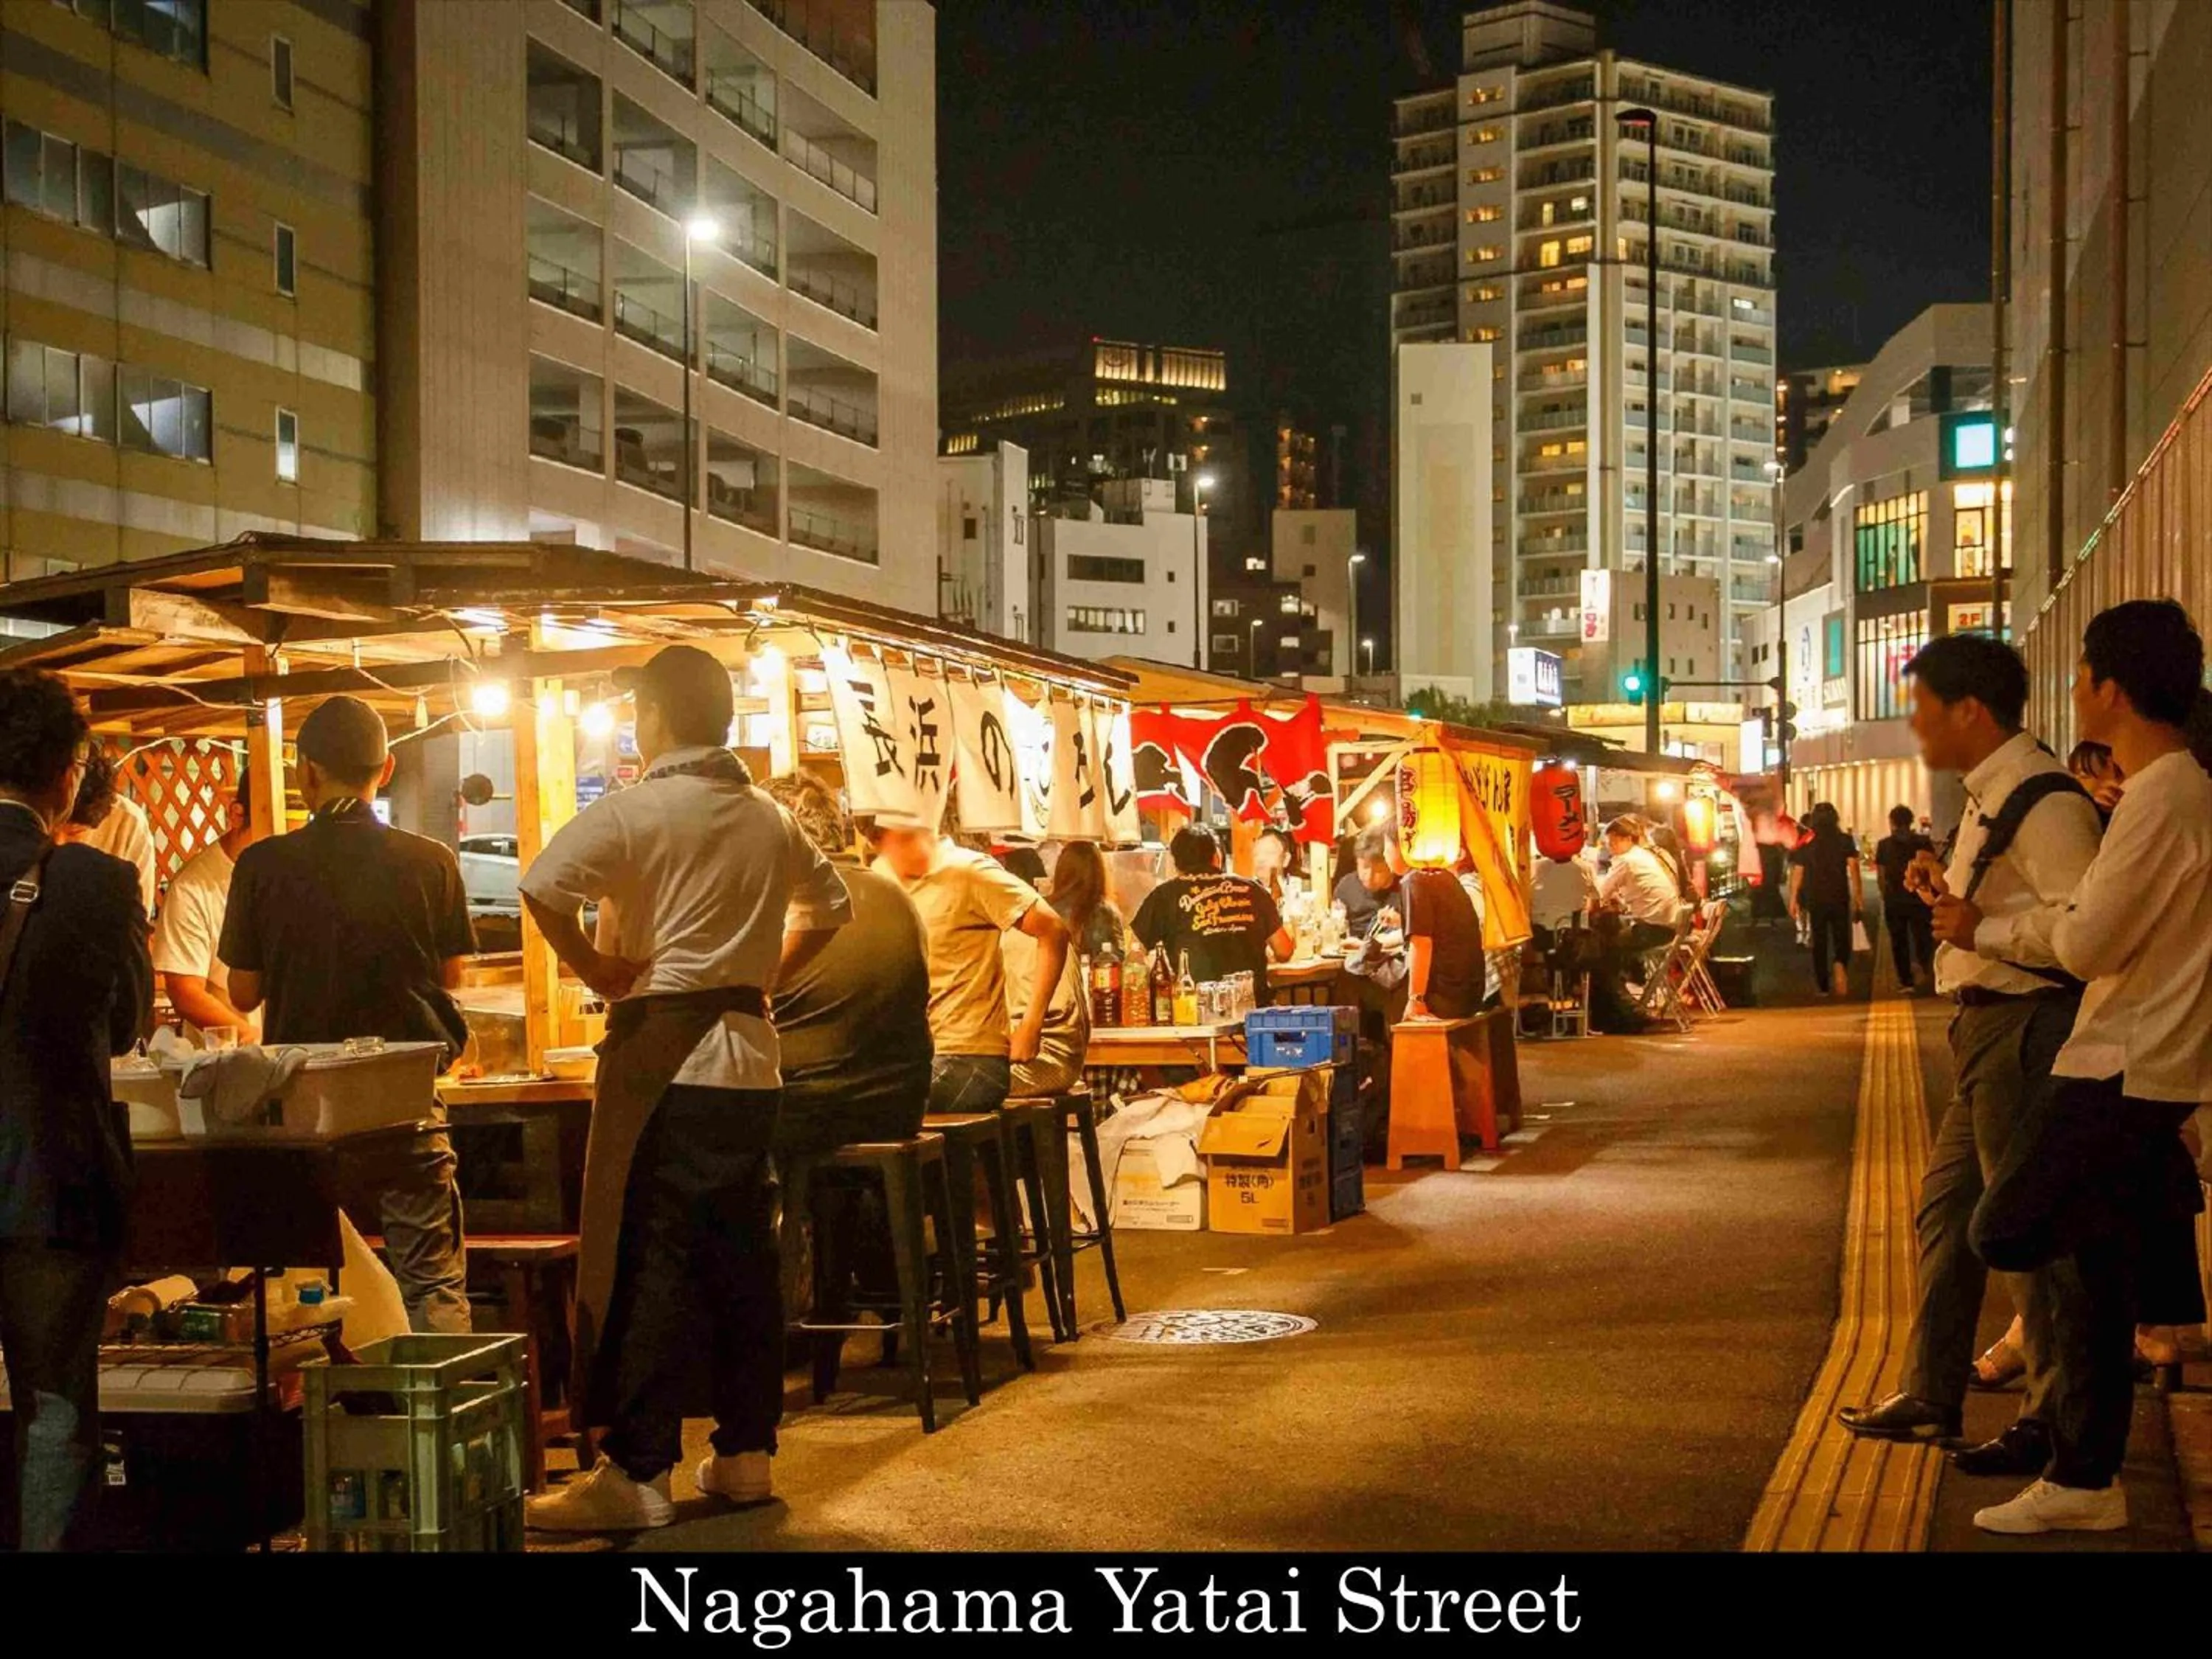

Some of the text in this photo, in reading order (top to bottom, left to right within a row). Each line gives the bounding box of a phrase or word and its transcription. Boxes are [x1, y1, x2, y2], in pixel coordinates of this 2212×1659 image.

[1554, 784, 1582, 841] ラーメン
[1241, 1191, 1260, 1204] 5L
